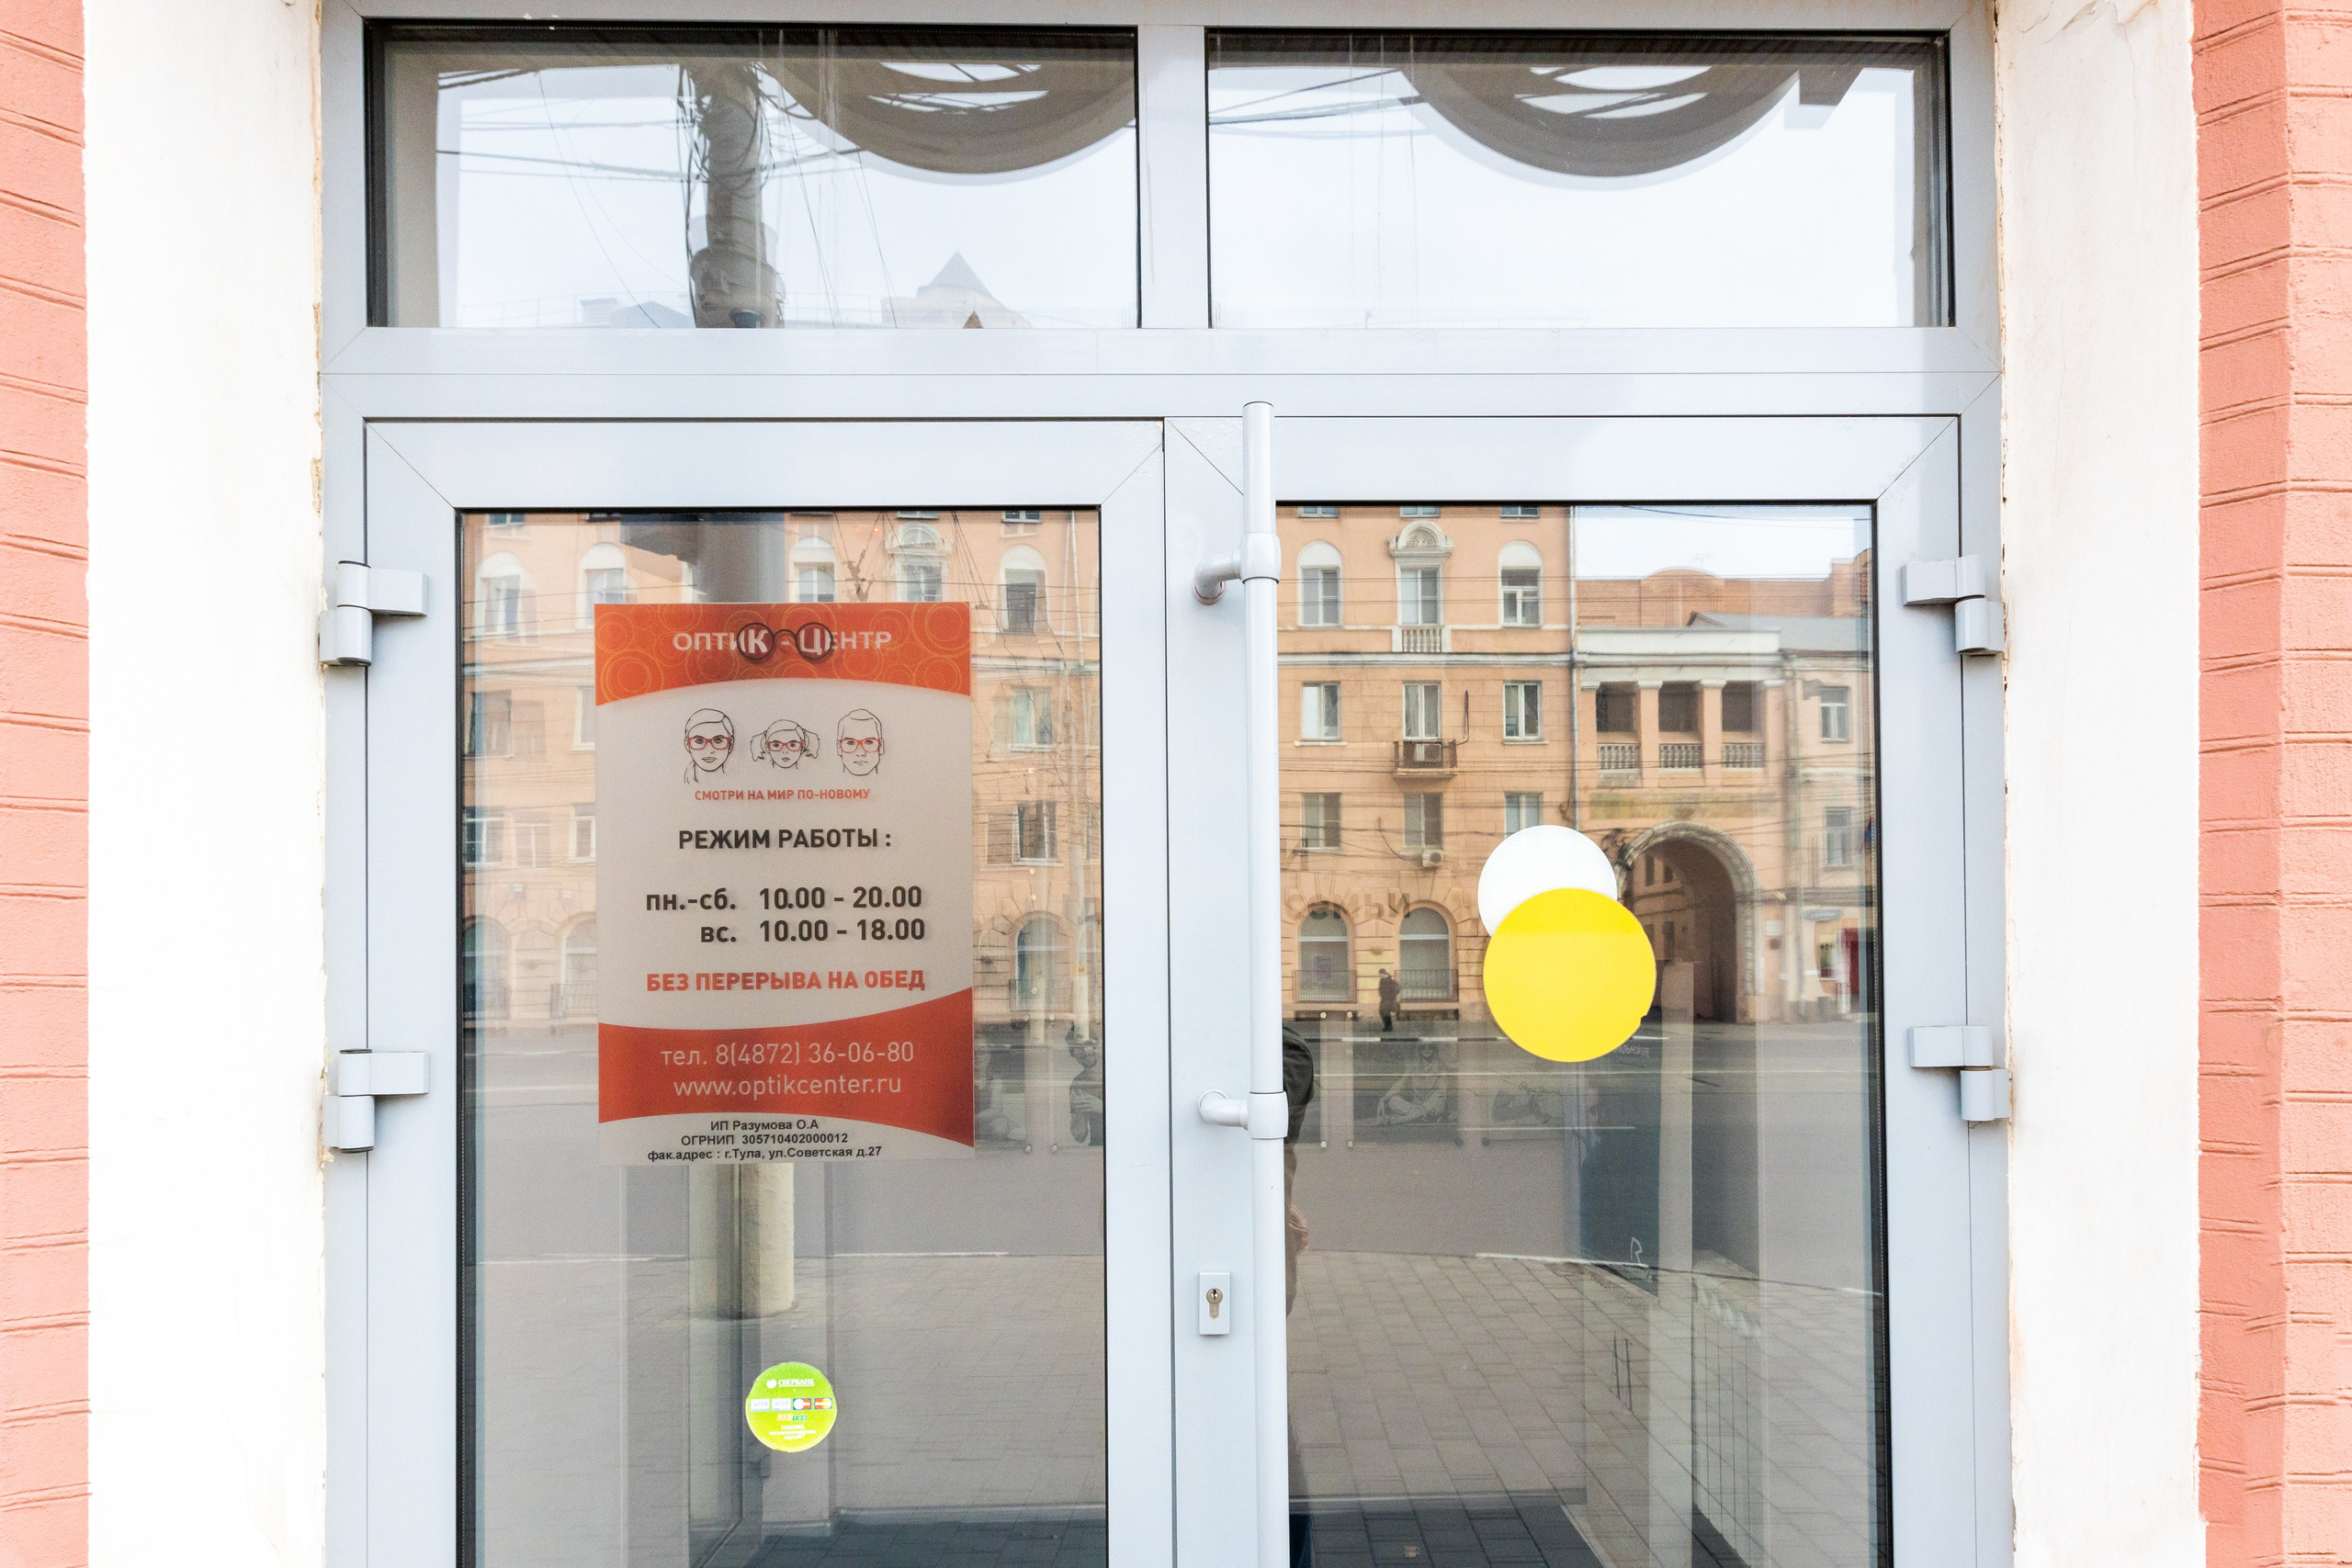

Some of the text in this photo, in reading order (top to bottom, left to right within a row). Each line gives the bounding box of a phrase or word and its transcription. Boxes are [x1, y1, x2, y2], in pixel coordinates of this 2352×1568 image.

[672, 630, 768, 655] ОПТИК
[798, 629, 893, 655] ЦЕНТР
[694, 787, 871, 801] СМОТРИ НА МИР ПО-НОВОМУ
[679, 829, 771, 850] РЕЖИМ
[778, 828, 878, 849] РАБОТЫ
[646, 887, 736, 911] пн.-сб.
[759, 886, 825, 910] 10.00
[853, 886, 922, 908] 20.00
[700, 926, 737, 943] вс.
[760, 919, 829, 942] 10.00
[856, 918, 926, 942] 18.00
[646, 969, 926, 992] БЕЗ ПЕРЕРЫВА НА ОБЕД
[660, 1041, 915, 1067] тел. 8(4872) 36-06-80
[673, 1074, 902, 1101] www.optikcenter.ru
[709, 1119, 820, 1134] ИП Разумова О.А
[680, 1133, 849, 1147] ОГРНИП 305710402000012
[647, 1150, 713, 1162] фак.адрес
[724, 1148, 765, 1162] г.Тула,
[768, 1147, 853, 1161] ул.Советская
[855, 1145, 882, 1159] д.27
